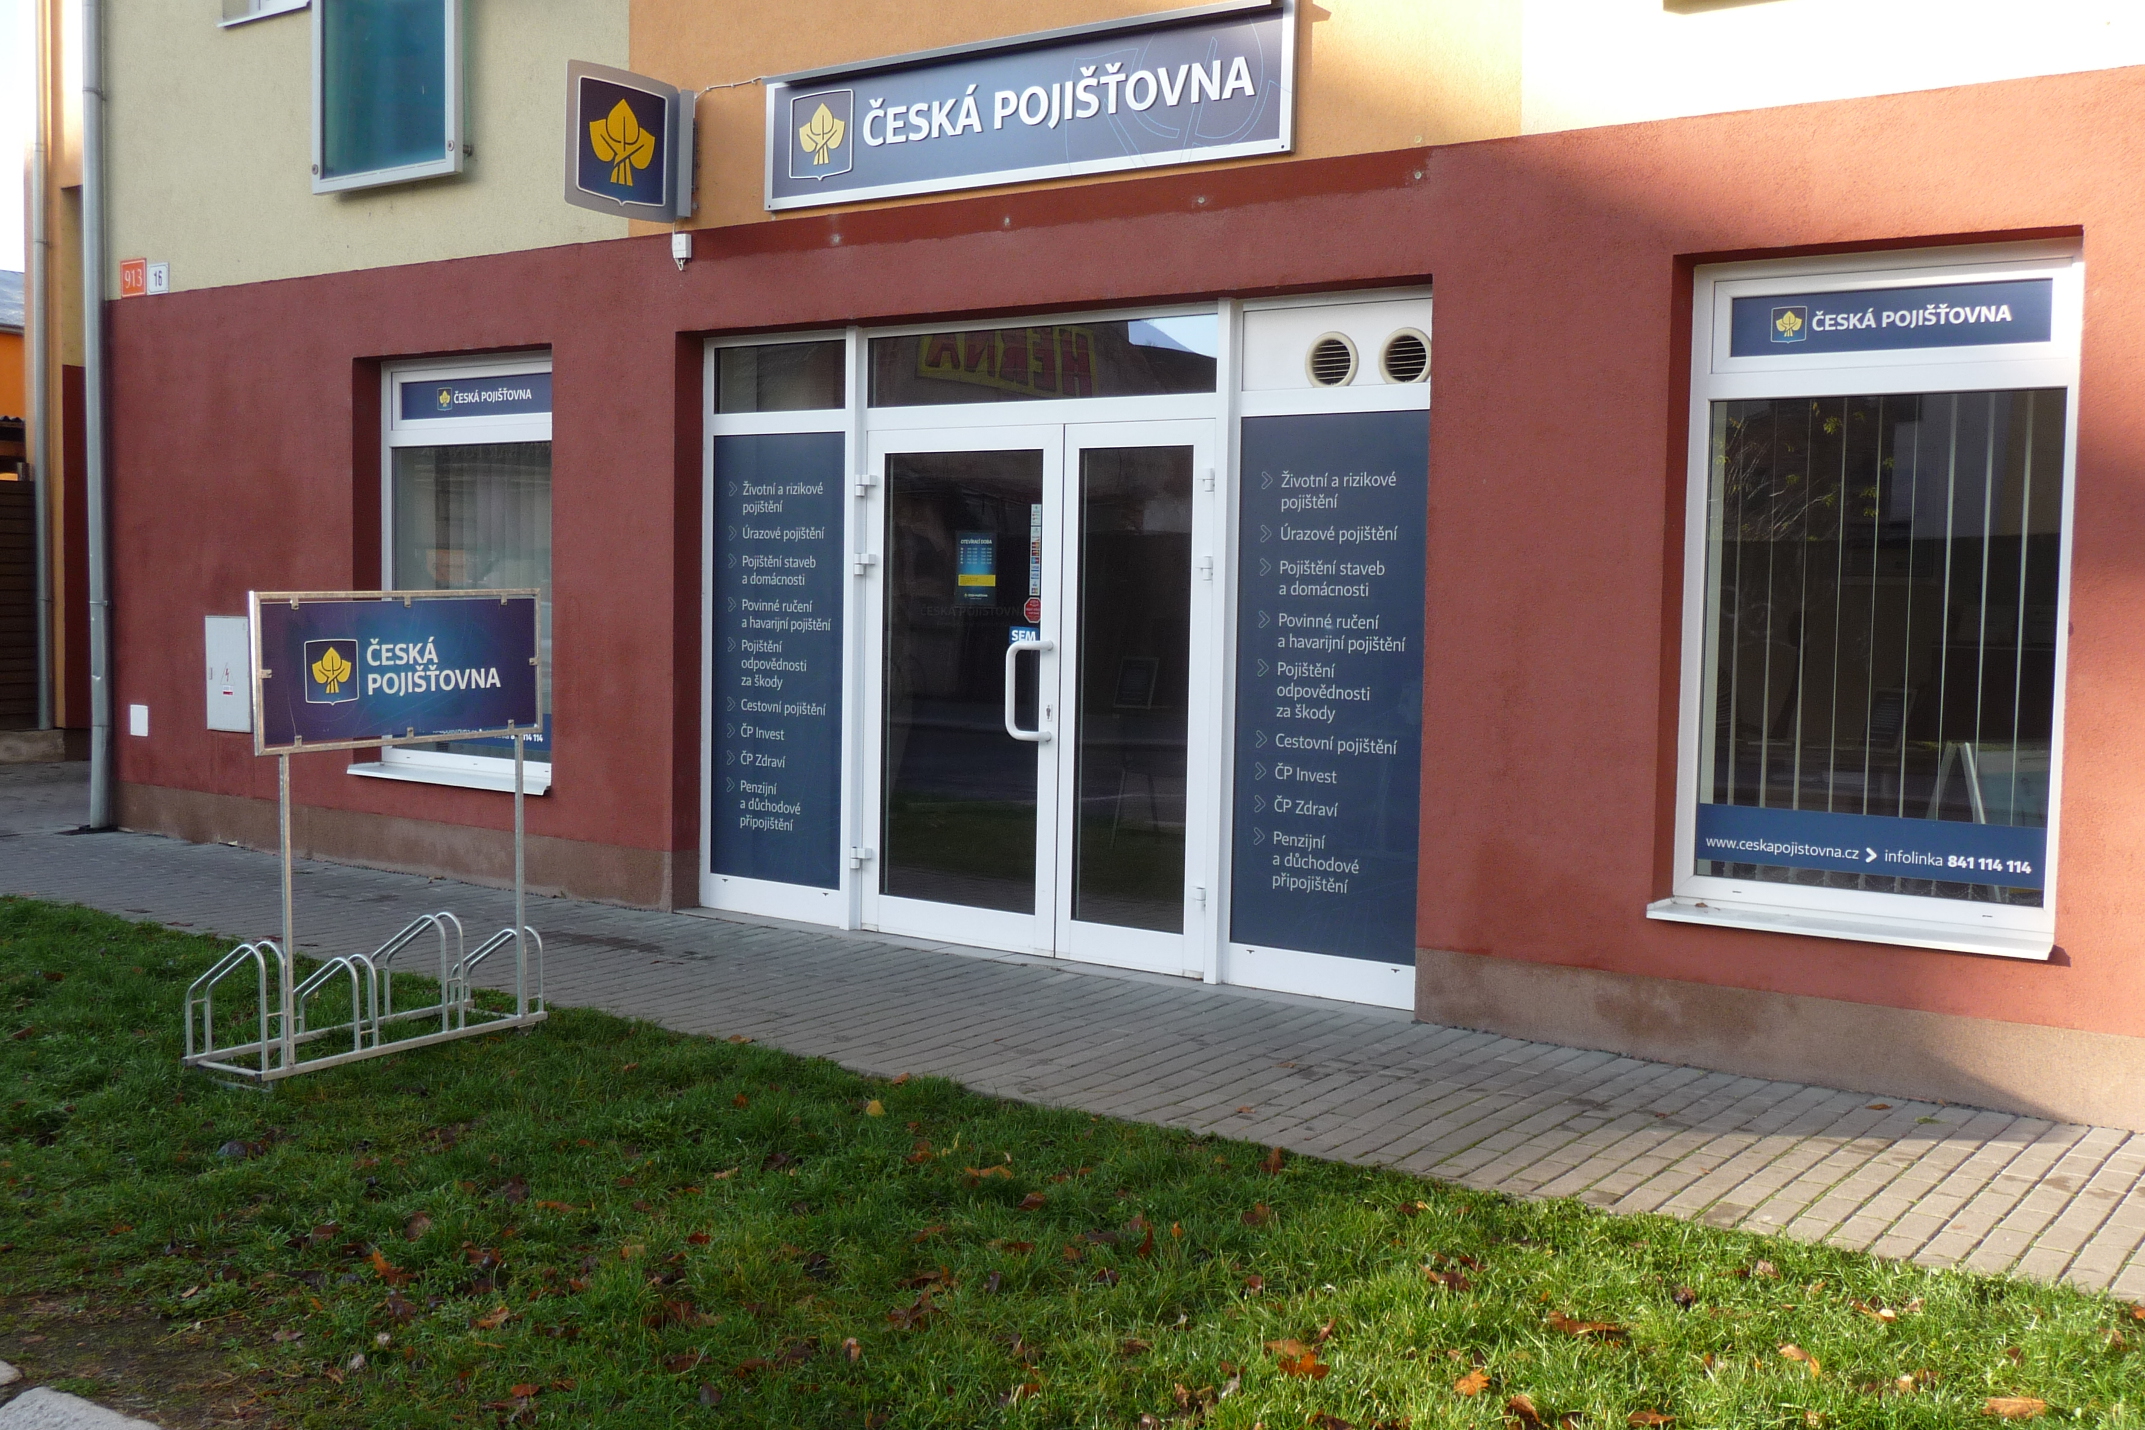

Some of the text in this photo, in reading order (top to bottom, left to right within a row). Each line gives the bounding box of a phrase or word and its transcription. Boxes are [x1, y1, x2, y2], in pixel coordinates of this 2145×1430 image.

[862, 56, 1256, 147] ČESKÁ POJIŠŤOVNA
[125, 269, 142, 288] 913
[154, 270, 162, 286] 16
[1812, 303, 2012, 332] ČESKÁ POJIŠŤOVNA
[454, 388, 532, 404] ČESKÁ POJIŠŤOVNA
[743, 481, 823, 495] Životní a rizikové
[1281, 471, 1396, 488] Životní a rizikové
[743, 500, 783, 515] pojištění
[1281, 494, 1338, 512] pojištění
[743, 524, 824, 542] Úrazové pojištění
[1281, 523, 1398, 544] Úrazové pojištění
[742, 555, 816, 570] Pojištění staveb
[1280, 560, 1385, 578] Pojištění staveb
[742, 573, 805, 585] a domácnosti
[1279, 581, 1369, 597] a domácnosti
[742, 599, 812, 612] Povinné ručení
[741, 616, 831, 633] a havarijní pojištění
[1278, 613, 1379, 629] Povinné ručení
[1012, 630, 1035, 641] SEM
[1278, 633, 1406, 654] a havarijní pojištění
[367, 636, 438, 666] ČESKÁ
[742, 639, 782, 654] Pojištění
[741, 658, 807, 672] odpovědnosti
[1278, 662, 1335, 680] Pojištění
[368, 664, 501, 696] POJIŠŤOVNA
[741, 675, 783, 690] za škody
[1277, 683, 1370, 701] odpovědnosti
[741, 699, 826, 717] Cestovní pojištění
[1276, 704, 1335, 724] za škody
[533, 734, 543, 742] 114
[741, 724, 784, 740] ČP Invest
[1275, 733, 1397, 756] Cestovní pojištění
[740, 751, 785, 768] ČP Zdraví
[1275, 763, 1337, 784] ČP Invest
[740, 780, 777, 797] Penzijní
[740, 798, 800, 815] a důchodové
[1274, 795, 1338, 817] ČP Zdraví
[740, 815, 793, 831] připojištění
[1273, 831, 1326, 851] Penzijní
[1273, 852, 1359, 874] a důchodové
[1706, 835, 2032, 874] www.ceskapojistovna.cz infolinka 841 114 114
[1273, 872, 1349, 894] připojištění
